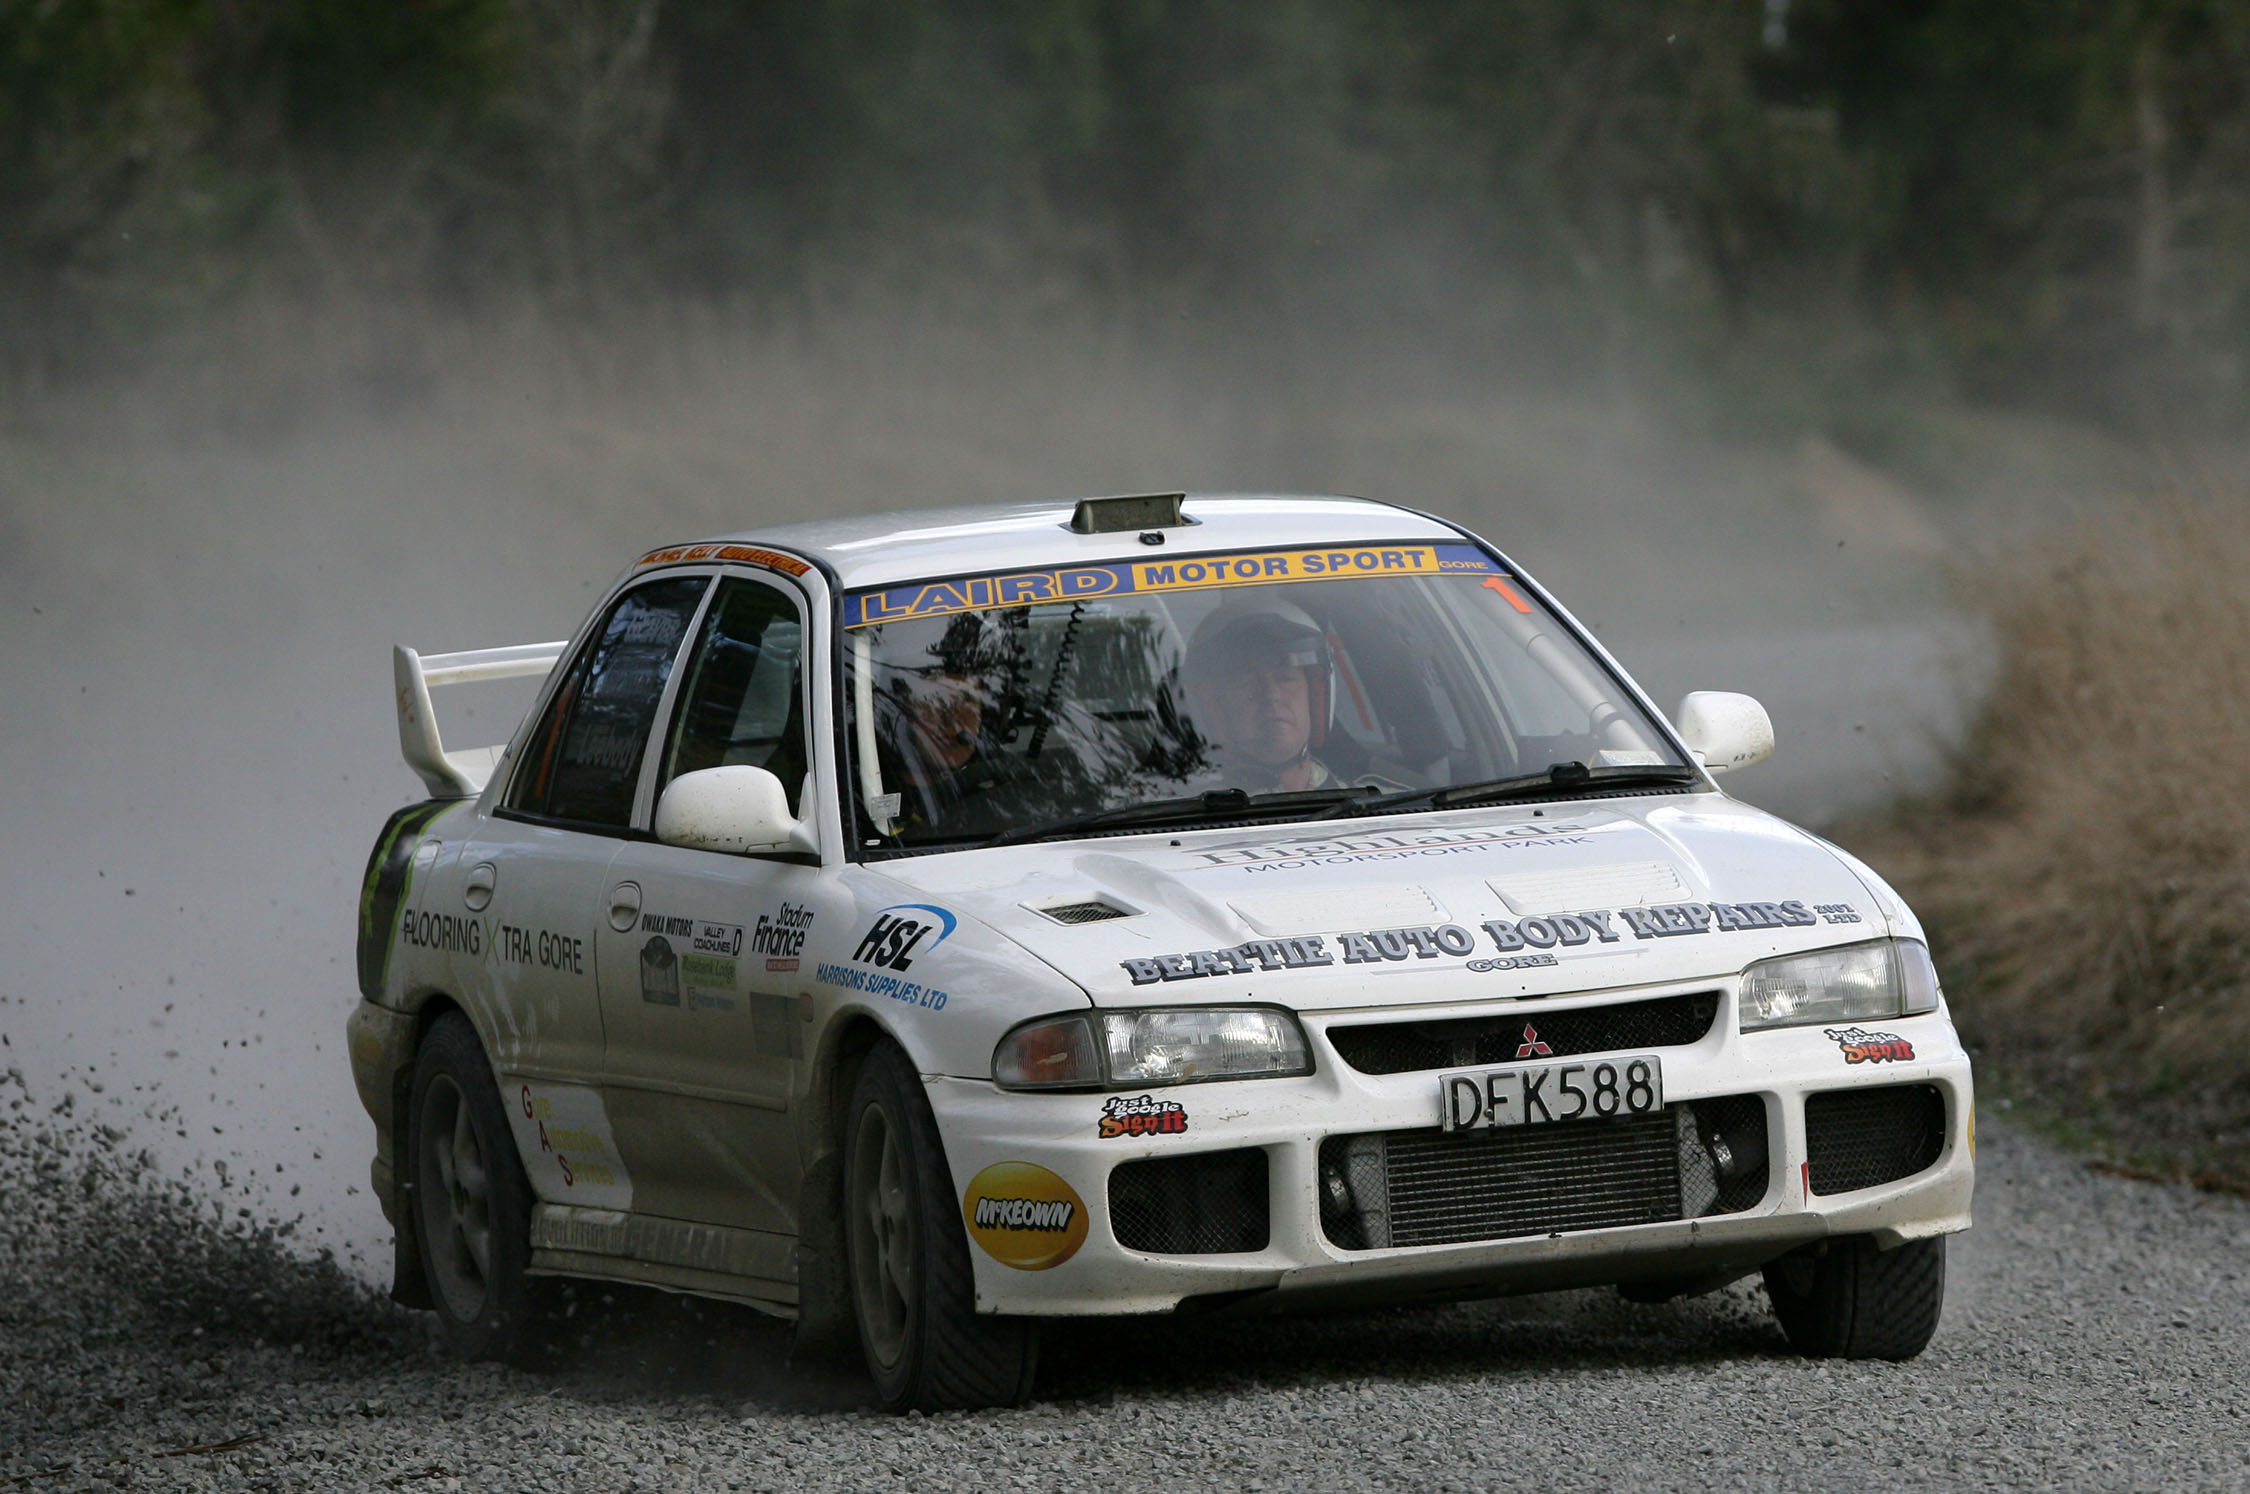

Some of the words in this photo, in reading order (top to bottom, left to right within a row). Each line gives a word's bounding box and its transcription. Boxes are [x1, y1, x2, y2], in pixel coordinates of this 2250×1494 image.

[1145, 550, 1289, 585] MOTOR
[1302, 549, 1426, 573] SPORT
[1438, 560, 1488, 570] GORE
[861, 568, 1118, 622] LAIRD
[1200, 822, 1590, 865] Highlands
[1243, 843, 1489, 873] MOTORSPORT
[1500, 834, 1596, 849] PARK
[641, 913, 665, 934] OWAKA
[664, 916, 694, 938] MOTORS
[703, 926, 726, 939] VALLEY
[752, 915, 806, 957] Finance
[1825, 913, 1863, 924] LTD
[403, 909, 480, 956] FLOORING
[538, 929, 583, 975] GORE
[694, 938, 731, 953] COACHLINES
[731, 928, 743, 957] D
[852, 913, 934, 972] HSL
[1120, 935, 1335, 986] BEATTIE
[1336, 924, 1475, 965] AUTO
[1483, 910, 1622, 953] BODY
[1619, 900, 1817, 940] REPAIRS
[1466, 953, 1559, 973] GORE
[816, 962, 867, 990] HARRISONS
[864, 973, 922, 1004] SUPPLIES
[919, 988, 948, 1012] LTD
[522, 1083, 552, 1119] Gore
[1105, 1096, 1151, 1111] Just
[1113, 1102, 1181, 1118] google
[1450, 1059, 1655, 1130] DFK588
[975, 1196, 1074, 1232] McKEOWN
